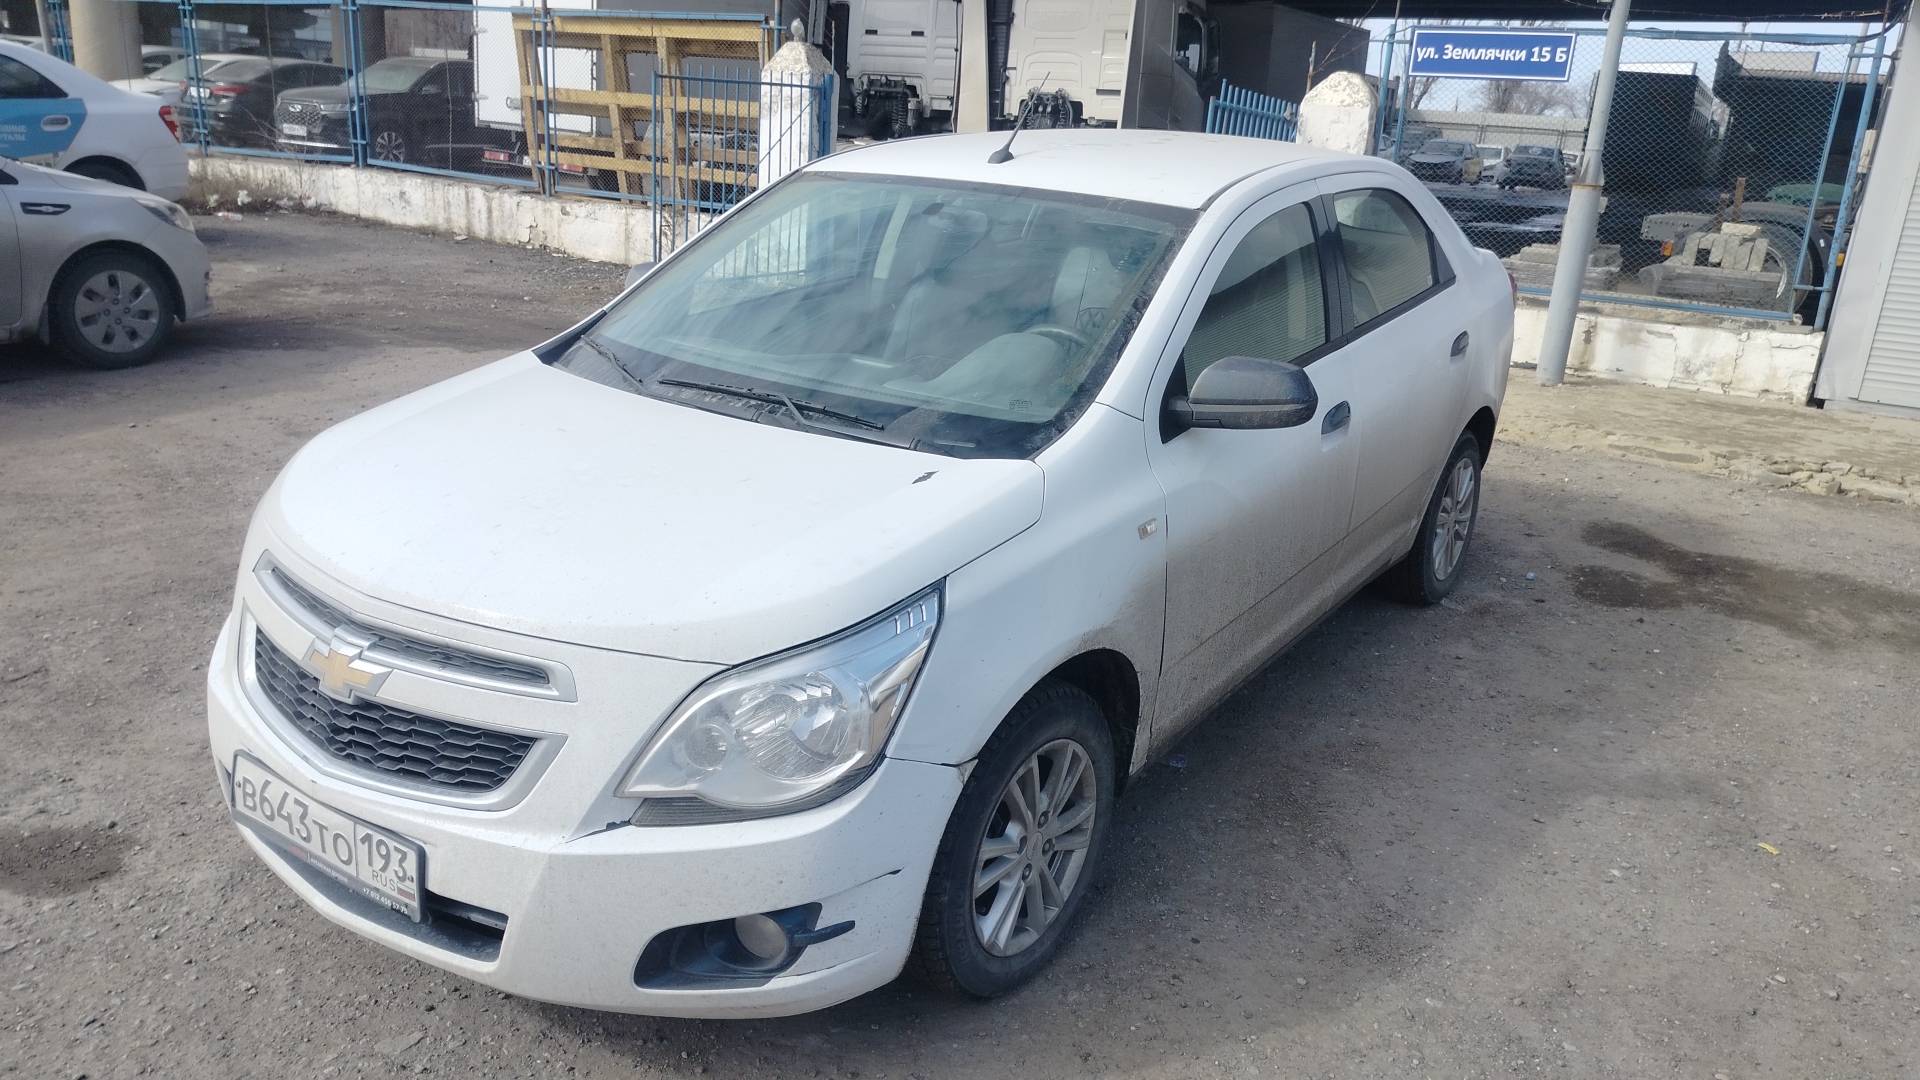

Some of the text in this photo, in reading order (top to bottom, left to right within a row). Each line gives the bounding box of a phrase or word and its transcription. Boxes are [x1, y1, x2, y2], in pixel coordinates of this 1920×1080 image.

[1416, 44, 1568, 63] ул. Землячки 15 Б
[242, 775, 353, 866] В643ТО
[359, 832, 408, 883] 193
[371, 869, 397, 892] RUS
